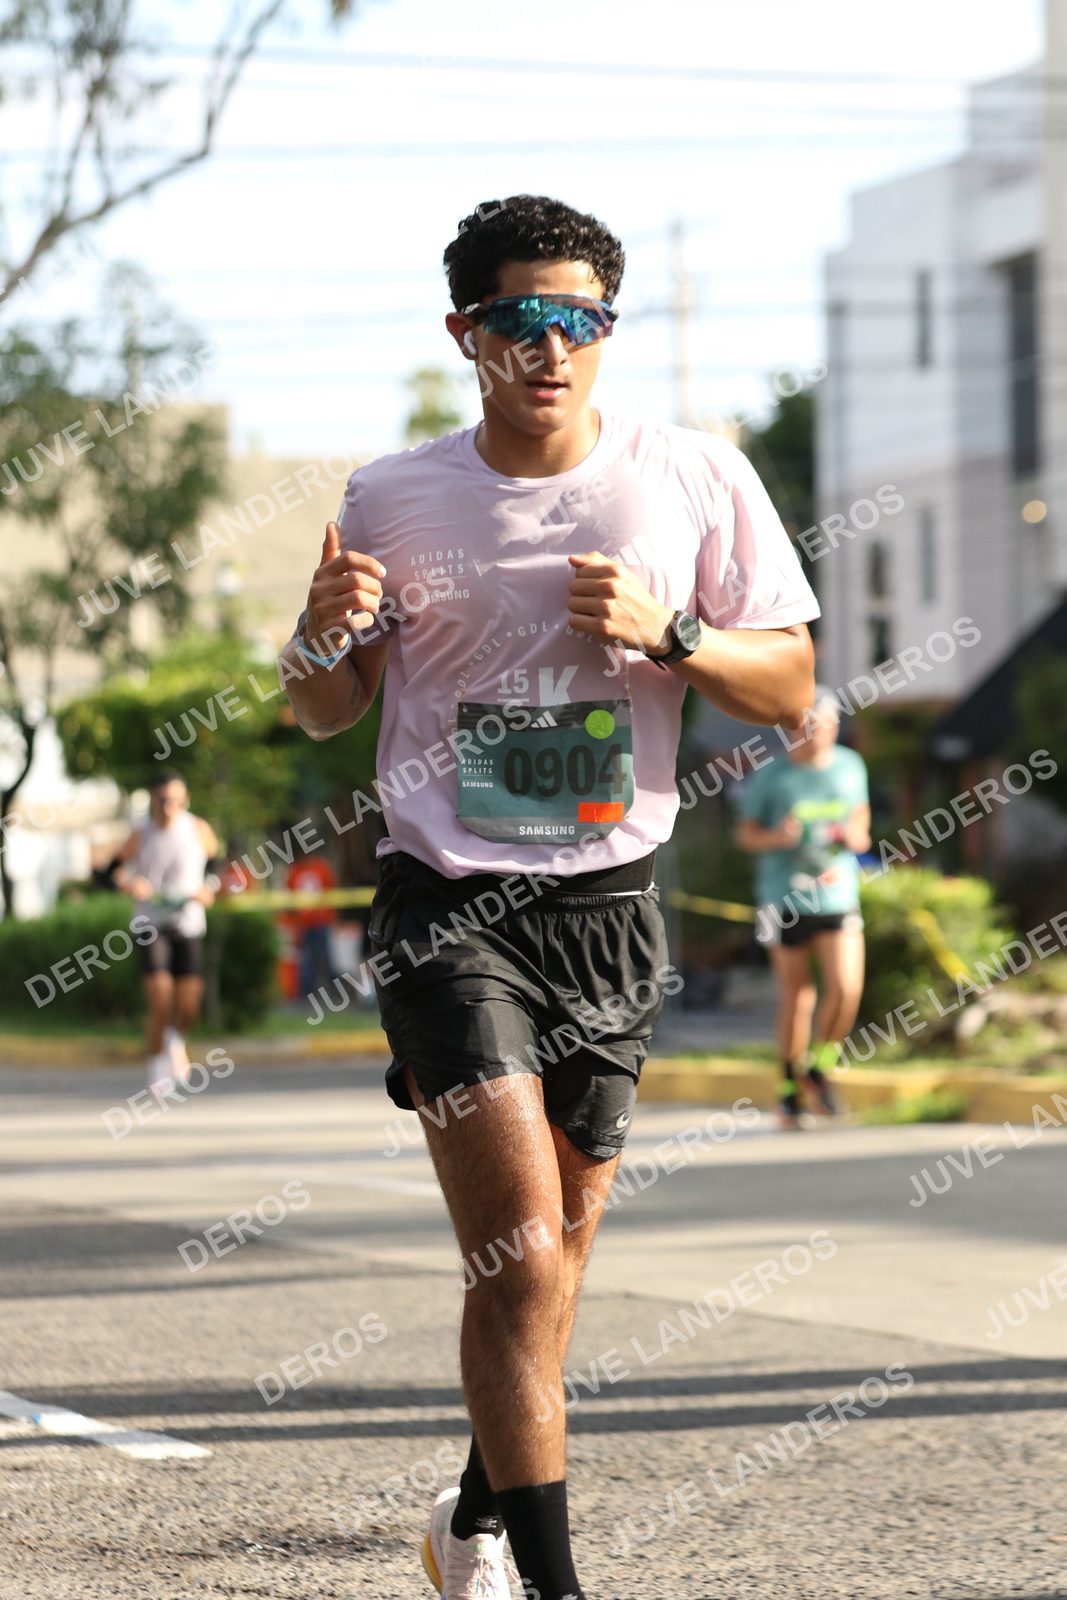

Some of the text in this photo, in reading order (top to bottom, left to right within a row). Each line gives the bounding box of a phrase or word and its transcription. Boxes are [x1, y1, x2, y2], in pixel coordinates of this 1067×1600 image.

[411, 548, 464, 567] ADIDAS
[414, 563, 464, 581] SPLITS
[474, 638, 501, 661] GDL
[518, 623, 550, 637] GDL
[497, 665, 579, 707] 15 K
[504, 743, 627, 797] 0904
[519, 825, 575, 836] SAMSUNG
